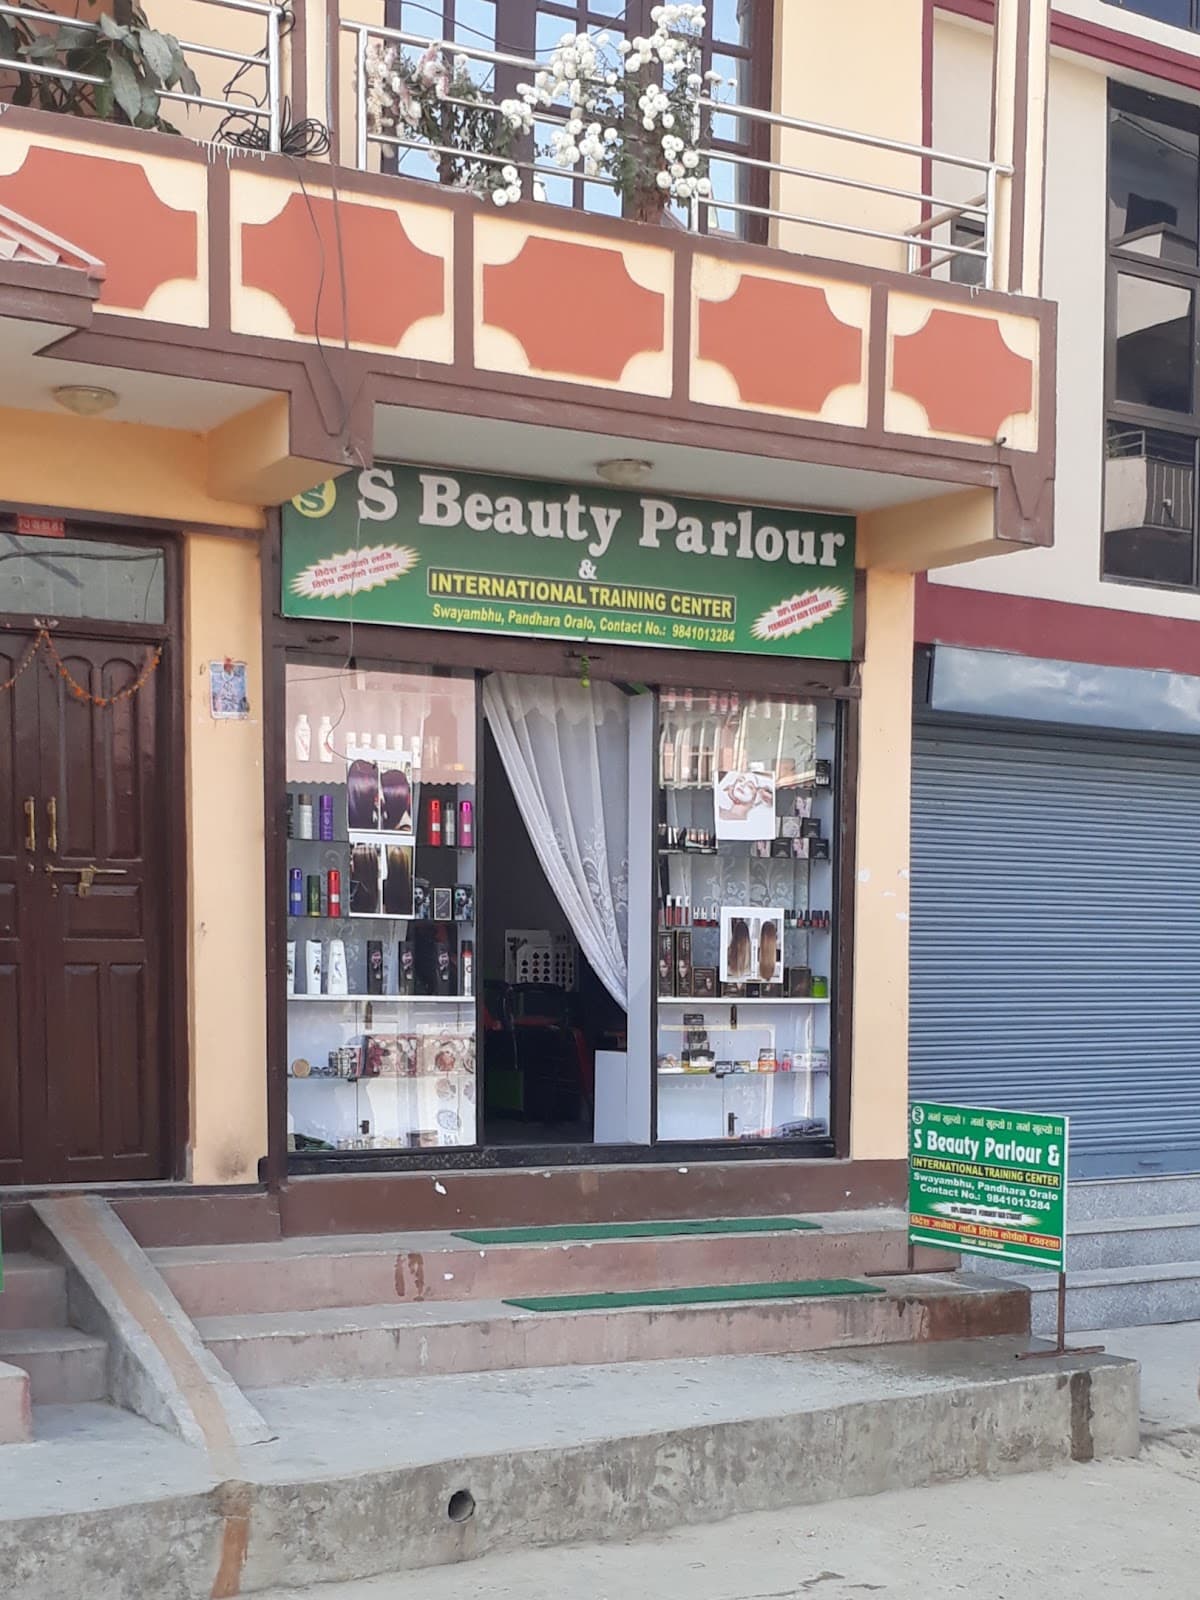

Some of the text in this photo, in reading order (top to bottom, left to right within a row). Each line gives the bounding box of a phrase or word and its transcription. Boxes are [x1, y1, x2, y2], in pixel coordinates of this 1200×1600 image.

[357, 468, 846, 567] S Beauty Parlour
[578, 559, 597, 580] &
[431, 572, 732, 618] INTERNATIONAL TRAINING CENTER
[433, 603, 735, 642] Swayambhu, Pandhara Oralo, Contact No.: 9841013284
[914, 1129, 1060, 1166] S Beauty Parlour &
[913, 1157, 1059, 1186] INTERNATIONAL TRAINING CENTER
[914, 1172, 1058, 1201] Swayambhu, Pandhara Oralo
[920, 1184, 1050, 1210] Contact No.: 9841013284
